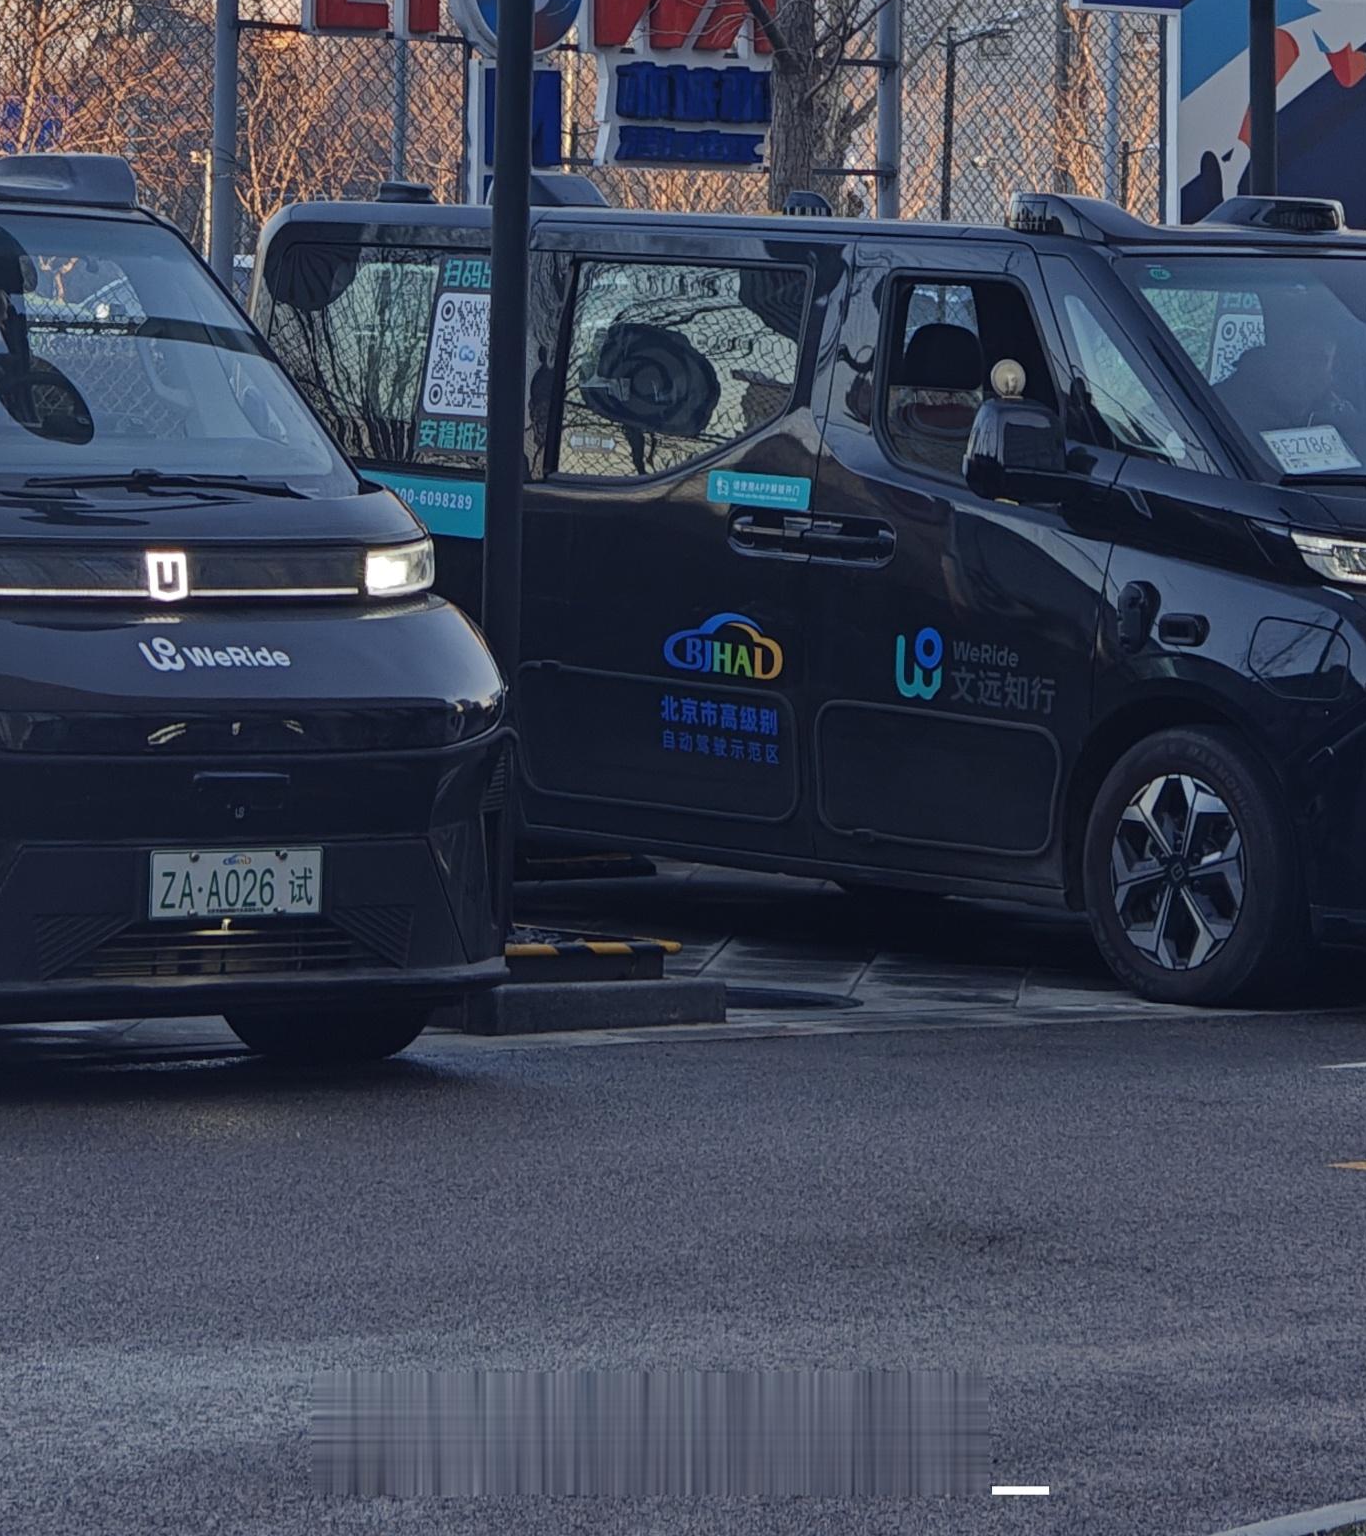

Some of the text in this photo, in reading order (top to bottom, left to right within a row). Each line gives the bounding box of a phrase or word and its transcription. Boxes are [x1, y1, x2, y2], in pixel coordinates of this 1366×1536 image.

[183, 645, 291, 667] WeRide
[952, 640, 1019, 669] WeRide
[949, 666, 1056, 716] 文远知行
[660, 694, 778, 736] 北京市高级别
[661, 729, 780, 765] 自动驾驶示范区
[288, 867, 313, 906] 试
